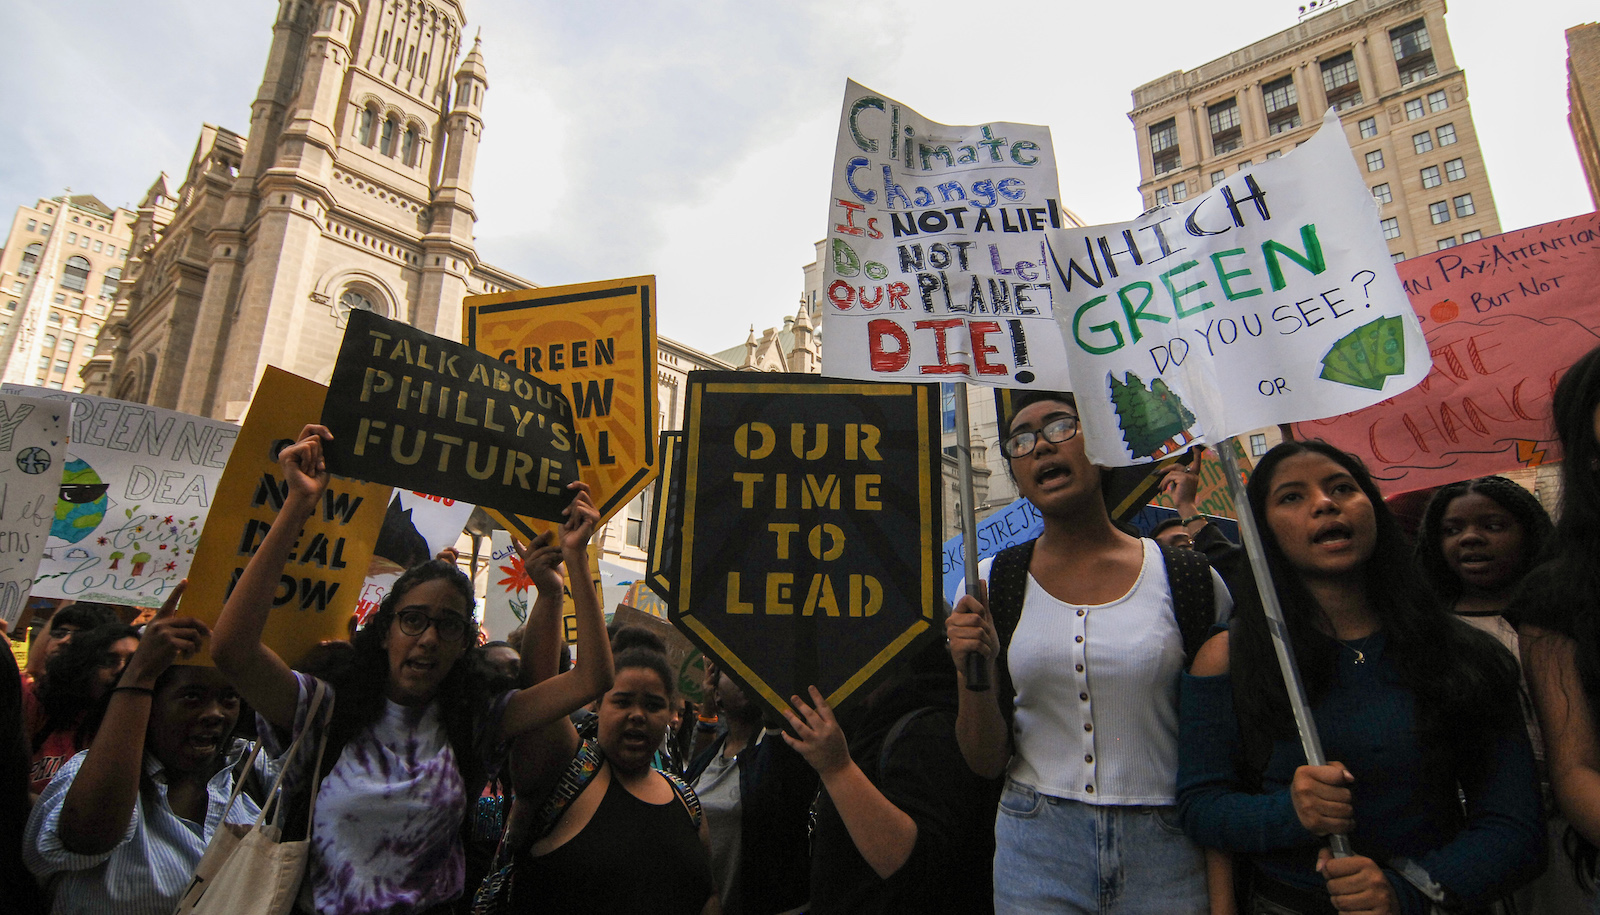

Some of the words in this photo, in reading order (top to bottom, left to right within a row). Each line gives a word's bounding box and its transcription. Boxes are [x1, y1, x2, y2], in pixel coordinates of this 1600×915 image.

[848, 96, 1040, 170] Climate
[845, 156, 1026, 209] Change
[834, 198, 884, 239] Is
[891, 206, 968, 237] NOT
[974, 207, 995, 233] A
[1045, 174, 1271, 292] WHICH
[832, 238, 889, 281] Do
[897, 241, 977, 273] NOT
[1435, 254, 1486, 283] PAY
[1493, 223, 1600, 268] ATTENTION
[826, 279, 910, 312] OUR
[1072, 224, 1326, 355] GREEN
[1470, 289, 1515, 313] BUT
[1519, 274, 1566, 297] NOT
[499, 338, 614, 373] GREEN
[867, 317, 1035, 384] DIE!
[1149, 337, 1189, 375] DO
[1195, 313, 1262, 356] YOU
[369, 330, 460, 378] TALK
[468, 363, 568, 416] ABOUT
[1258, 377, 1292, 397] OR
[43, 394, 174, 457] REEN
[172, 421, 237, 469] NE
[360, 367, 571, 451] PHILLY'S
[353, 417, 563, 495] FUTURE
[733, 421, 884, 461] OUR
[124, 465, 208, 507] DEA
[251, 472, 364, 525] NW
[733, 472, 883, 511] TIME
[768, 523, 846, 561] TO
[726, 571, 884, 618] LEAD
